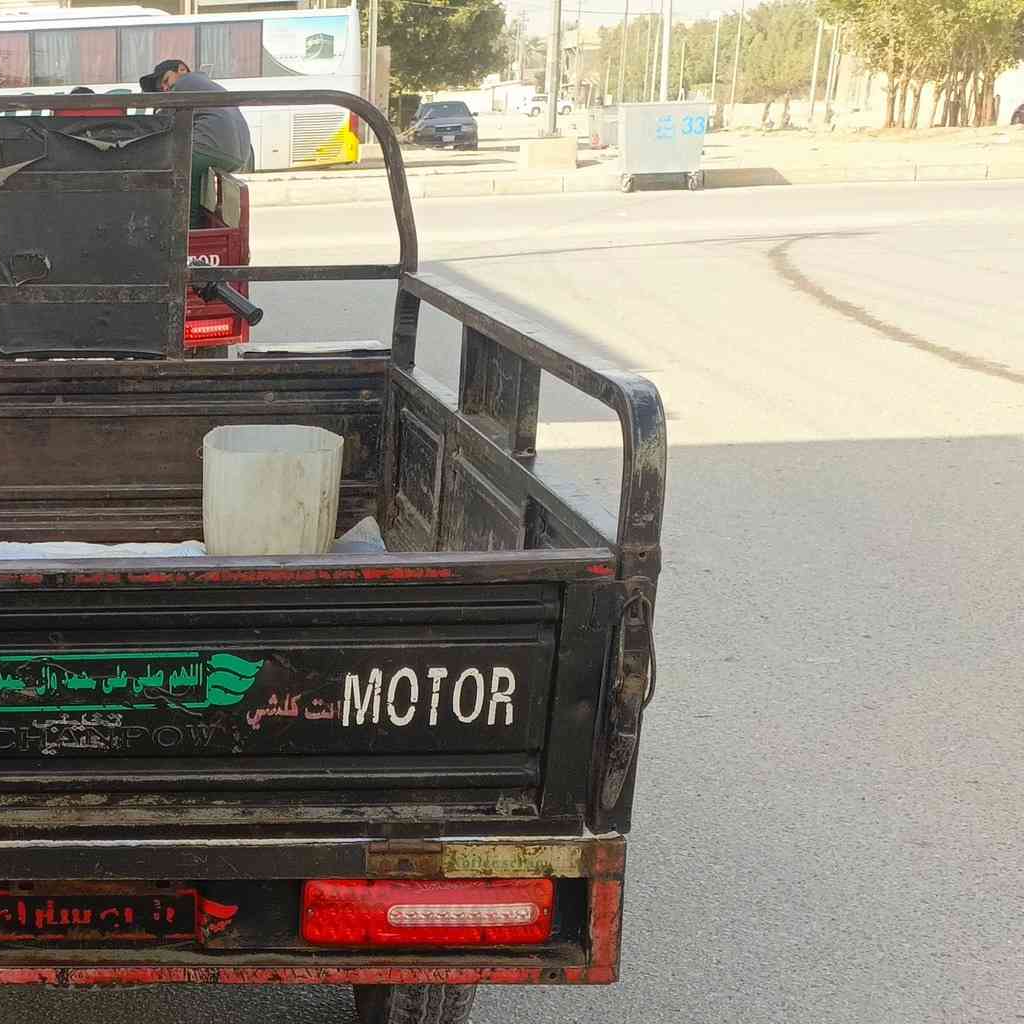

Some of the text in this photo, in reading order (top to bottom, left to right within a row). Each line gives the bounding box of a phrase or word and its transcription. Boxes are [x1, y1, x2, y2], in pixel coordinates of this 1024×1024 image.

[681, 115, 706, 135] 33
[169, 662, 203, 696] اللهم
[342, 666, 516, 727] MOTOR
